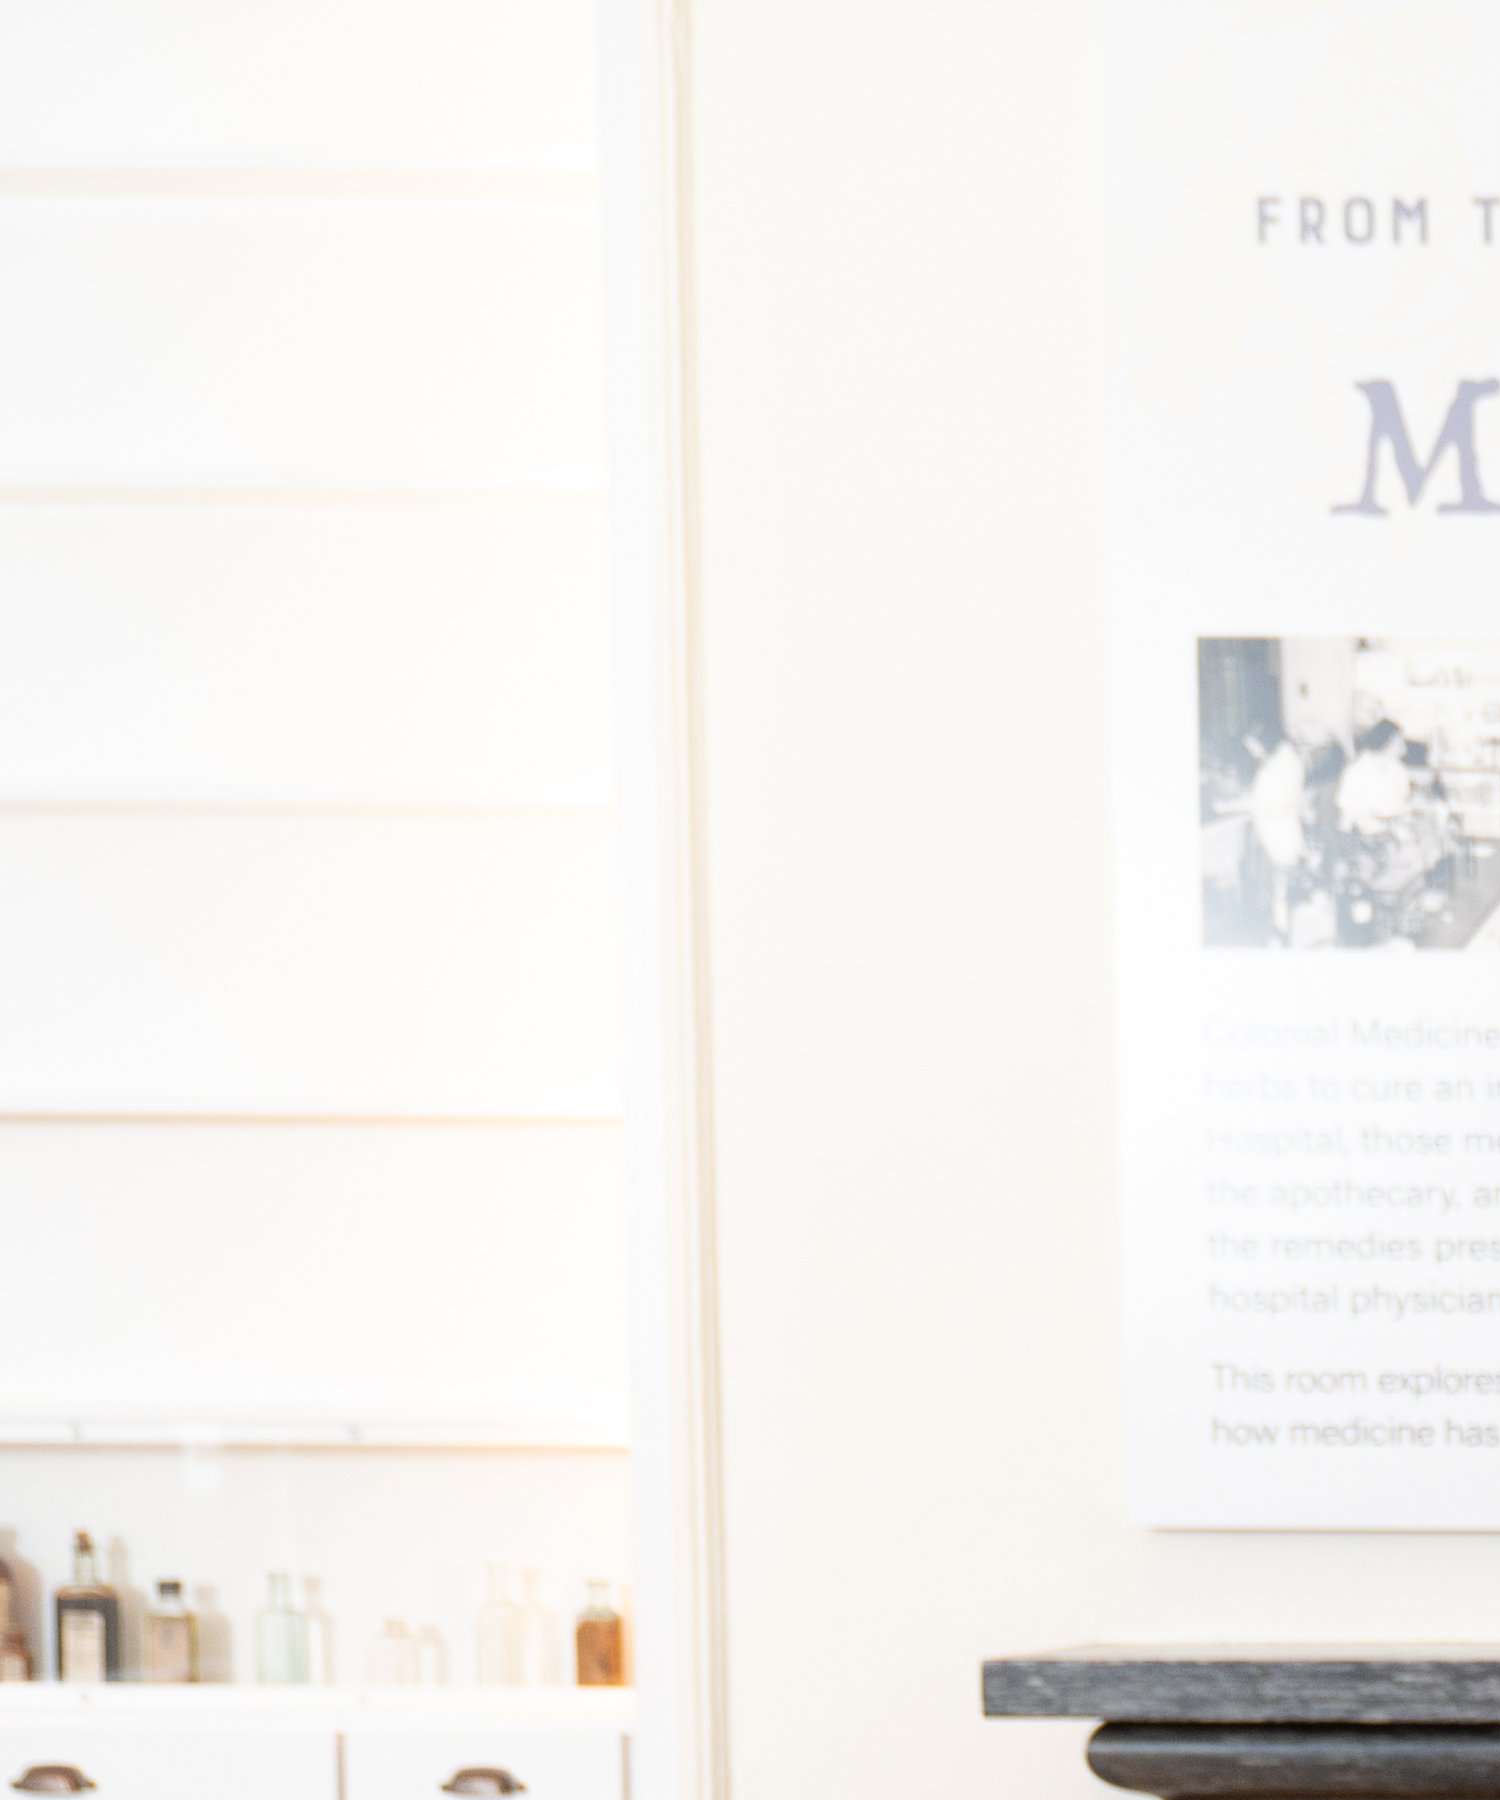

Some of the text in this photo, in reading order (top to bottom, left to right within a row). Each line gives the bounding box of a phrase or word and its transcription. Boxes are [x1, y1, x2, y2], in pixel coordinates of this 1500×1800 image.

[1256, 196, 1430, 246] FROM
[1349, 1077, 1424, 1103] cure
[1432, 1078, 1475, 1103] an
[1359, 1124, 1452, 1156] those
[1205, 1178, 1259, 1208] the
[1206, 1230, 1260, 1260] the
[1269, 1230, 1423, 1261] remedies
[1207, 1282, 1339, 1318] hospital
[1210, 1361, 1276, 1394] This
[1283, 1369, 1368, 1394] room
[1209, 1416, 1280, 1446] how
[1288, 1416, 1436, 1447] medicine
[1442, 1417, 1500, 1448] has
